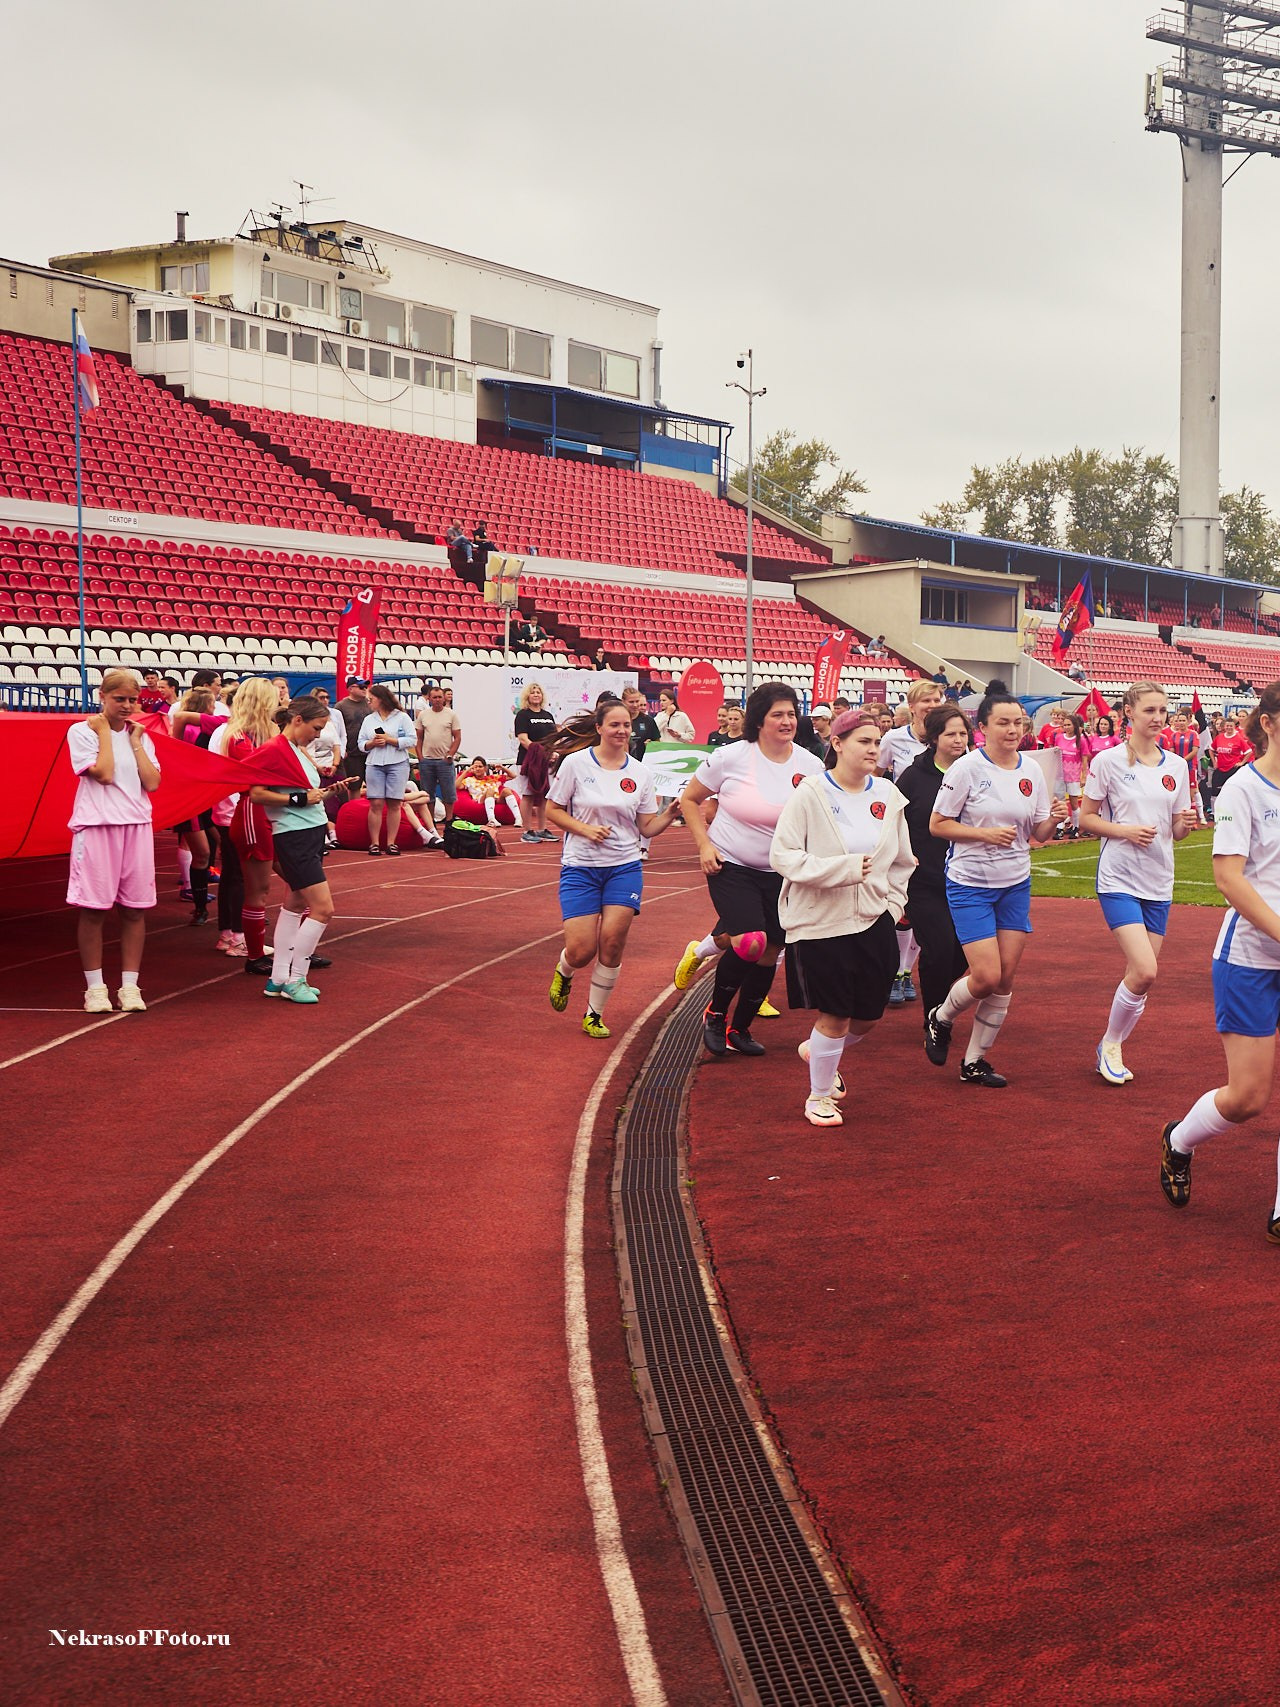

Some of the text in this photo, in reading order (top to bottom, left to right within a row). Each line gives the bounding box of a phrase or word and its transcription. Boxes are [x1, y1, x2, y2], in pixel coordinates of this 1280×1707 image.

[109, 515, 132, 524] СЕКТОР
[1123, 773, 1136, 781] FN
[979, 780, 992, 788] FN
[1264, 809, 1278, 821] FN
